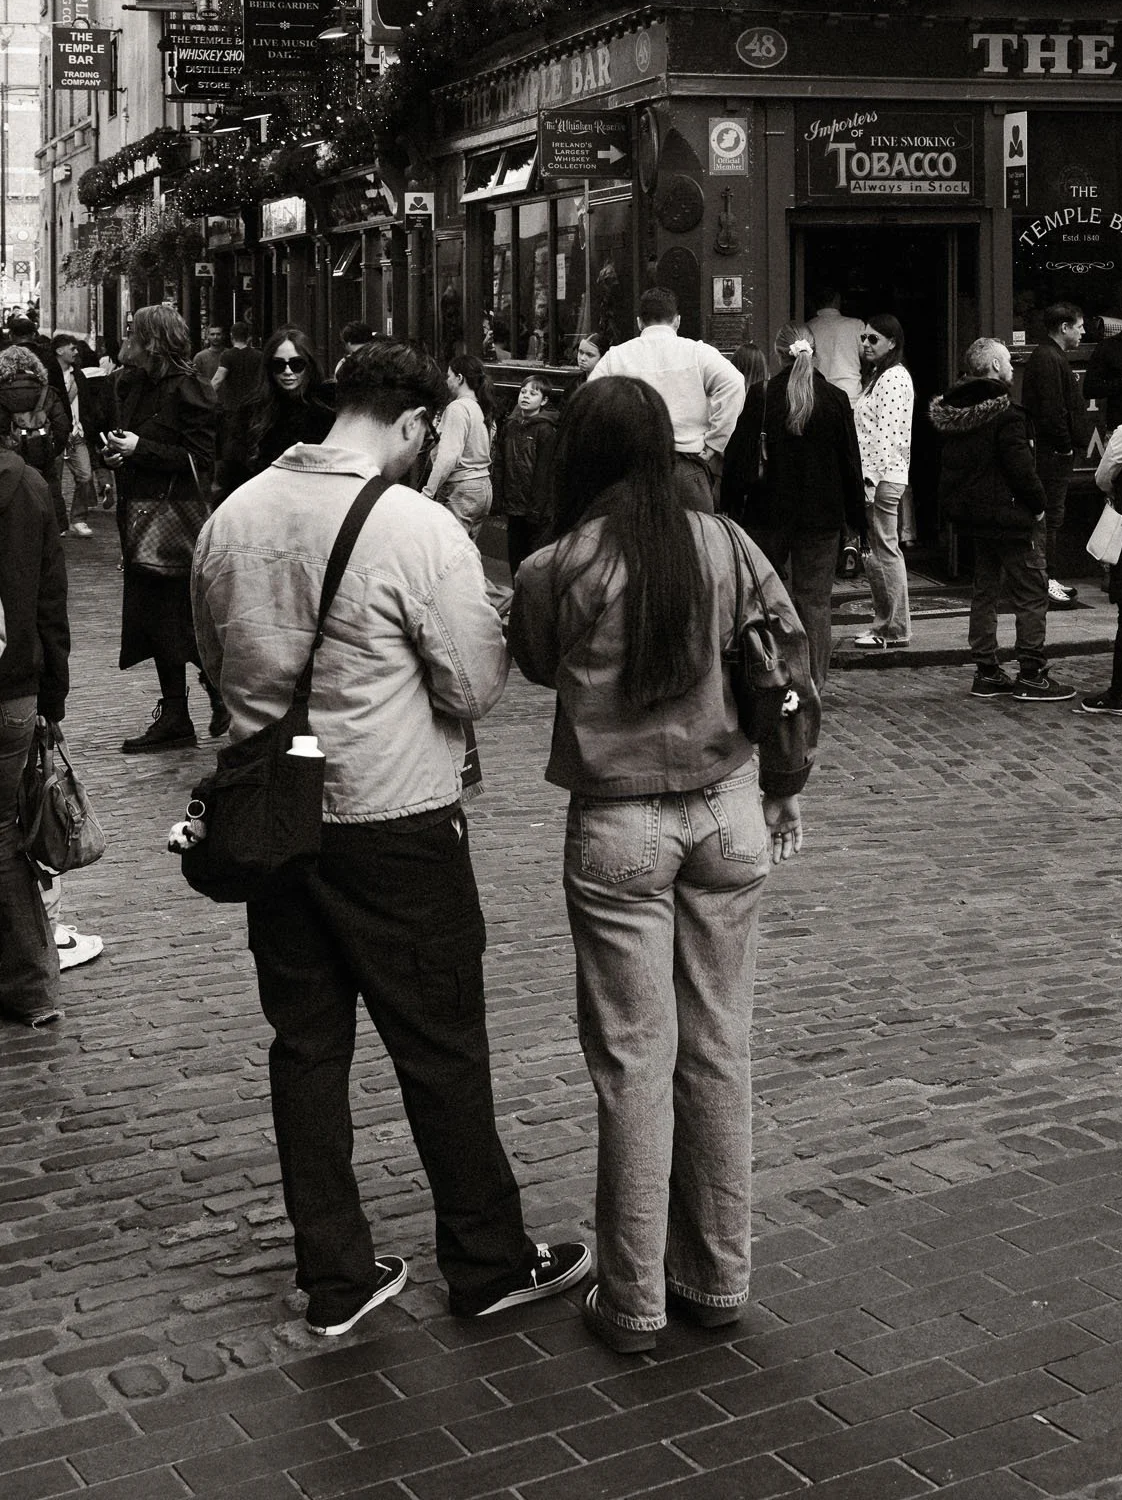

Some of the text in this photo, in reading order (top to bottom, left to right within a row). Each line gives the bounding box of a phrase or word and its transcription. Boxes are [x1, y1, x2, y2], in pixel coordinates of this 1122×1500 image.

[249, 0, 320, 10] BEER GARDEN
[70, 32, 93, 42] THE
[170, 35, 191, 44] THE
[193, 36, 232, 45] TEMPLE
[58, 43, 105, 54] TEMPLE
[252, 39, 318, 48] LIVE MUSIC
[744, 33, 776, 58] 48
[68, 55, 94, 65] BAR
[179, 48, 244, 61] WHISKEY SHO
[973, 33, 1117, 76] THE
[64, 71, 100, 79] TRADING
[185, 65, 243, 74] DISTILLERY
[570, 45, 611, 95] BAR
[61, 79, 101, 87] COMPANY
[197, 81, 231, 89] STORE
[544, 119, 627, 136] The Whiskey Reserve
[804, 110, 878, 141] Importers
[850, 129, 864, 138] OF
[871, 136, 956, 148] FINE SMOKING
[824, 143, 957, 188] TOBACCO
[852, 180, 968, 194] Always in Stock
[1070, 185, 1098, 198] THE
[1019, 206, 1102, 247] TEMPLE
[1062, 234, 1100, 242] Estd. 1840
